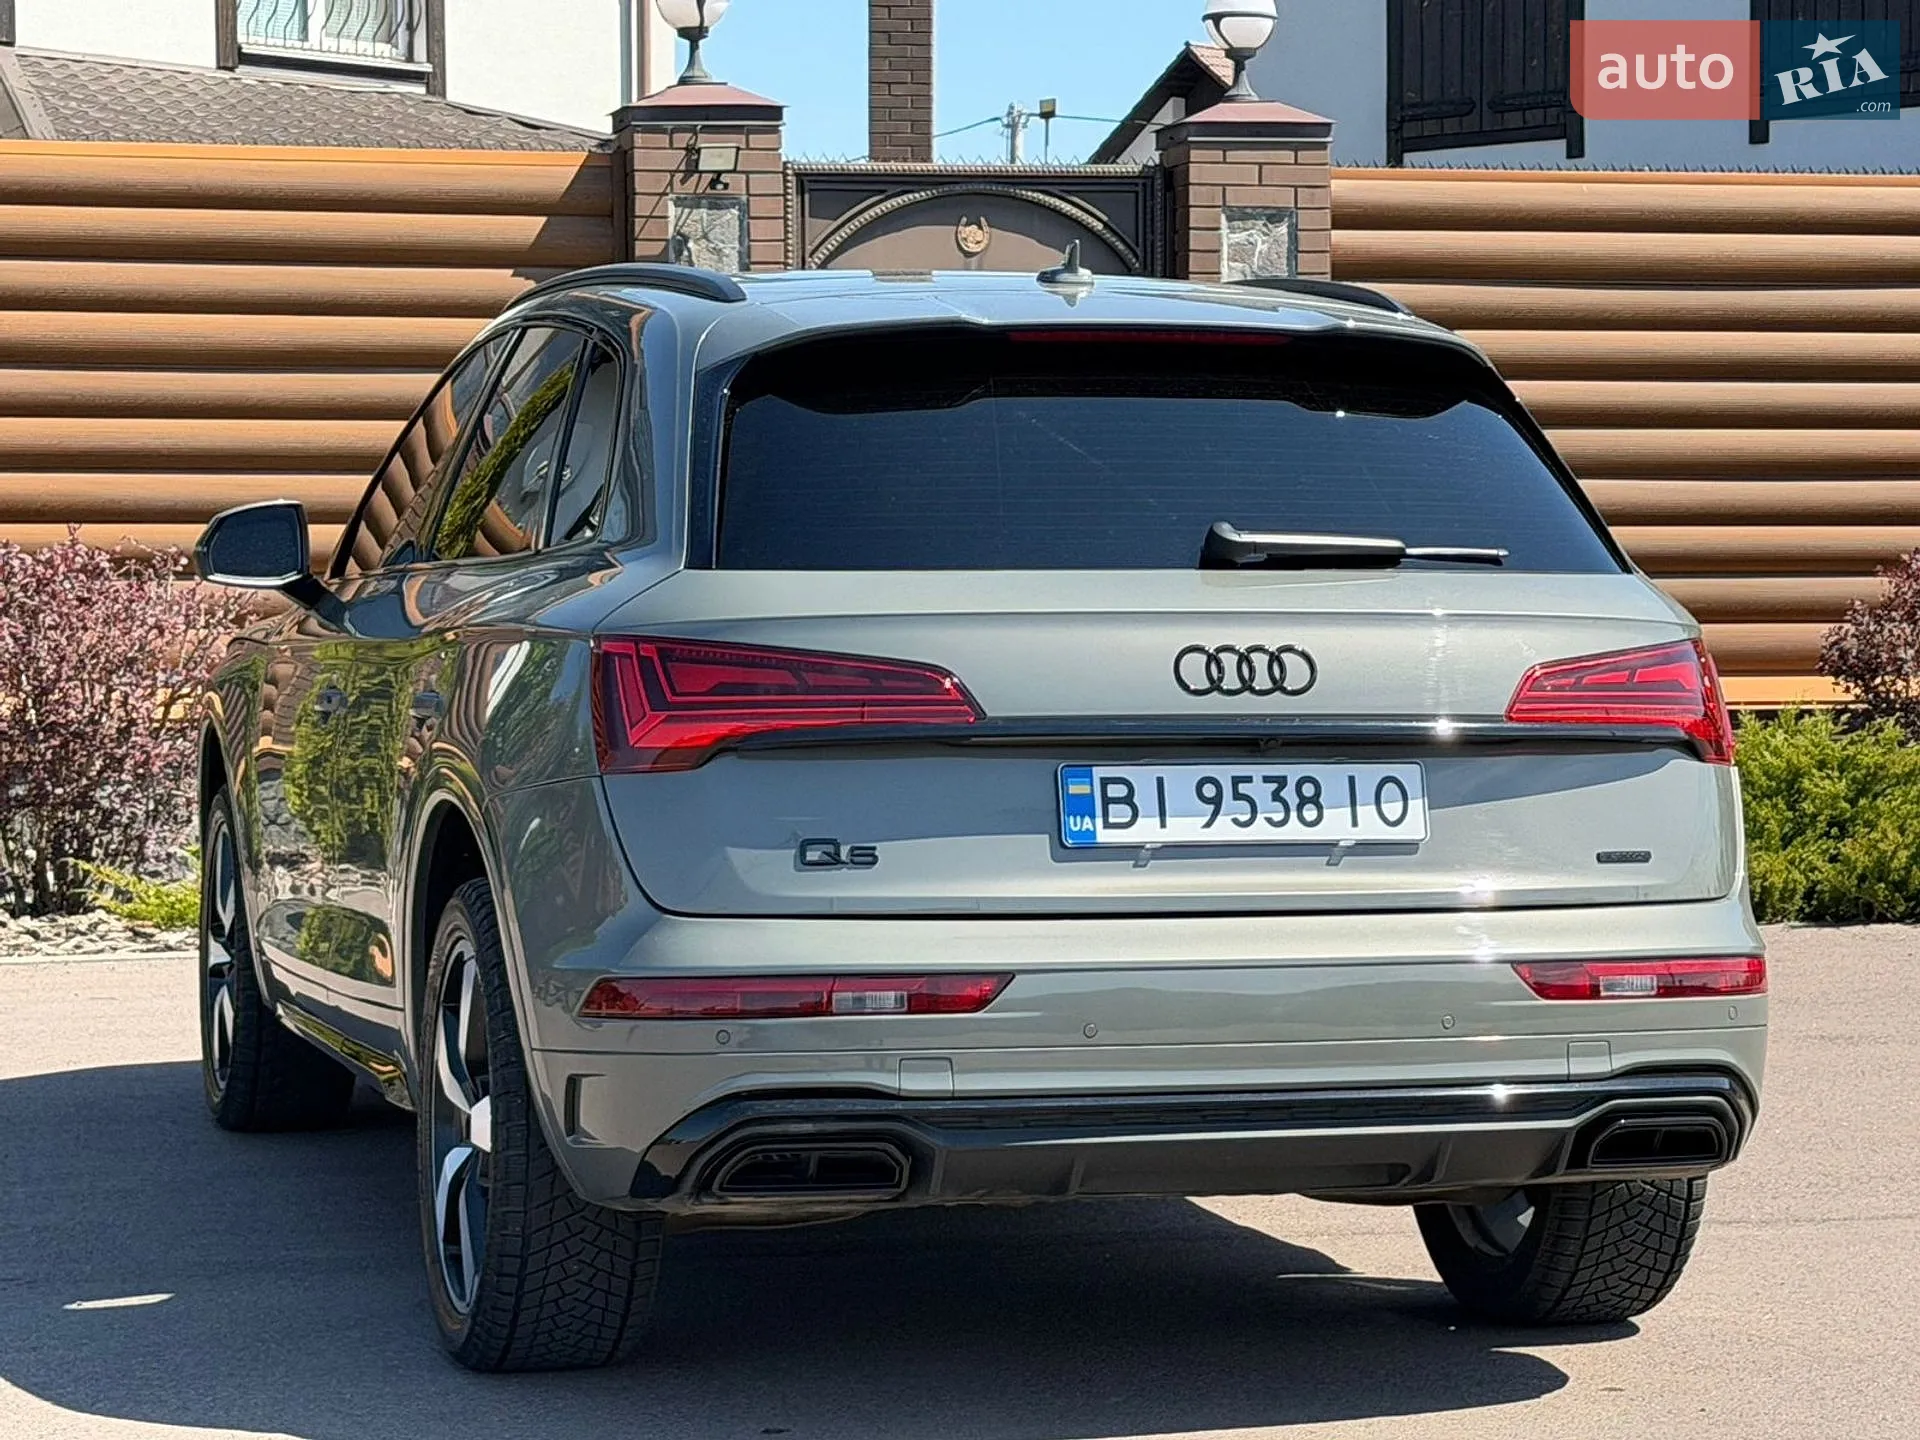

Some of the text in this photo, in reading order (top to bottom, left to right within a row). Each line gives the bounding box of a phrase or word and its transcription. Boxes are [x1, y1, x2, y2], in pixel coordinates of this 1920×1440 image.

[1099, 774, 1409, 829] BI 9538 IO
[1069, 815, 1094, 832] UA
[799, 838, 879, 867] Q5
